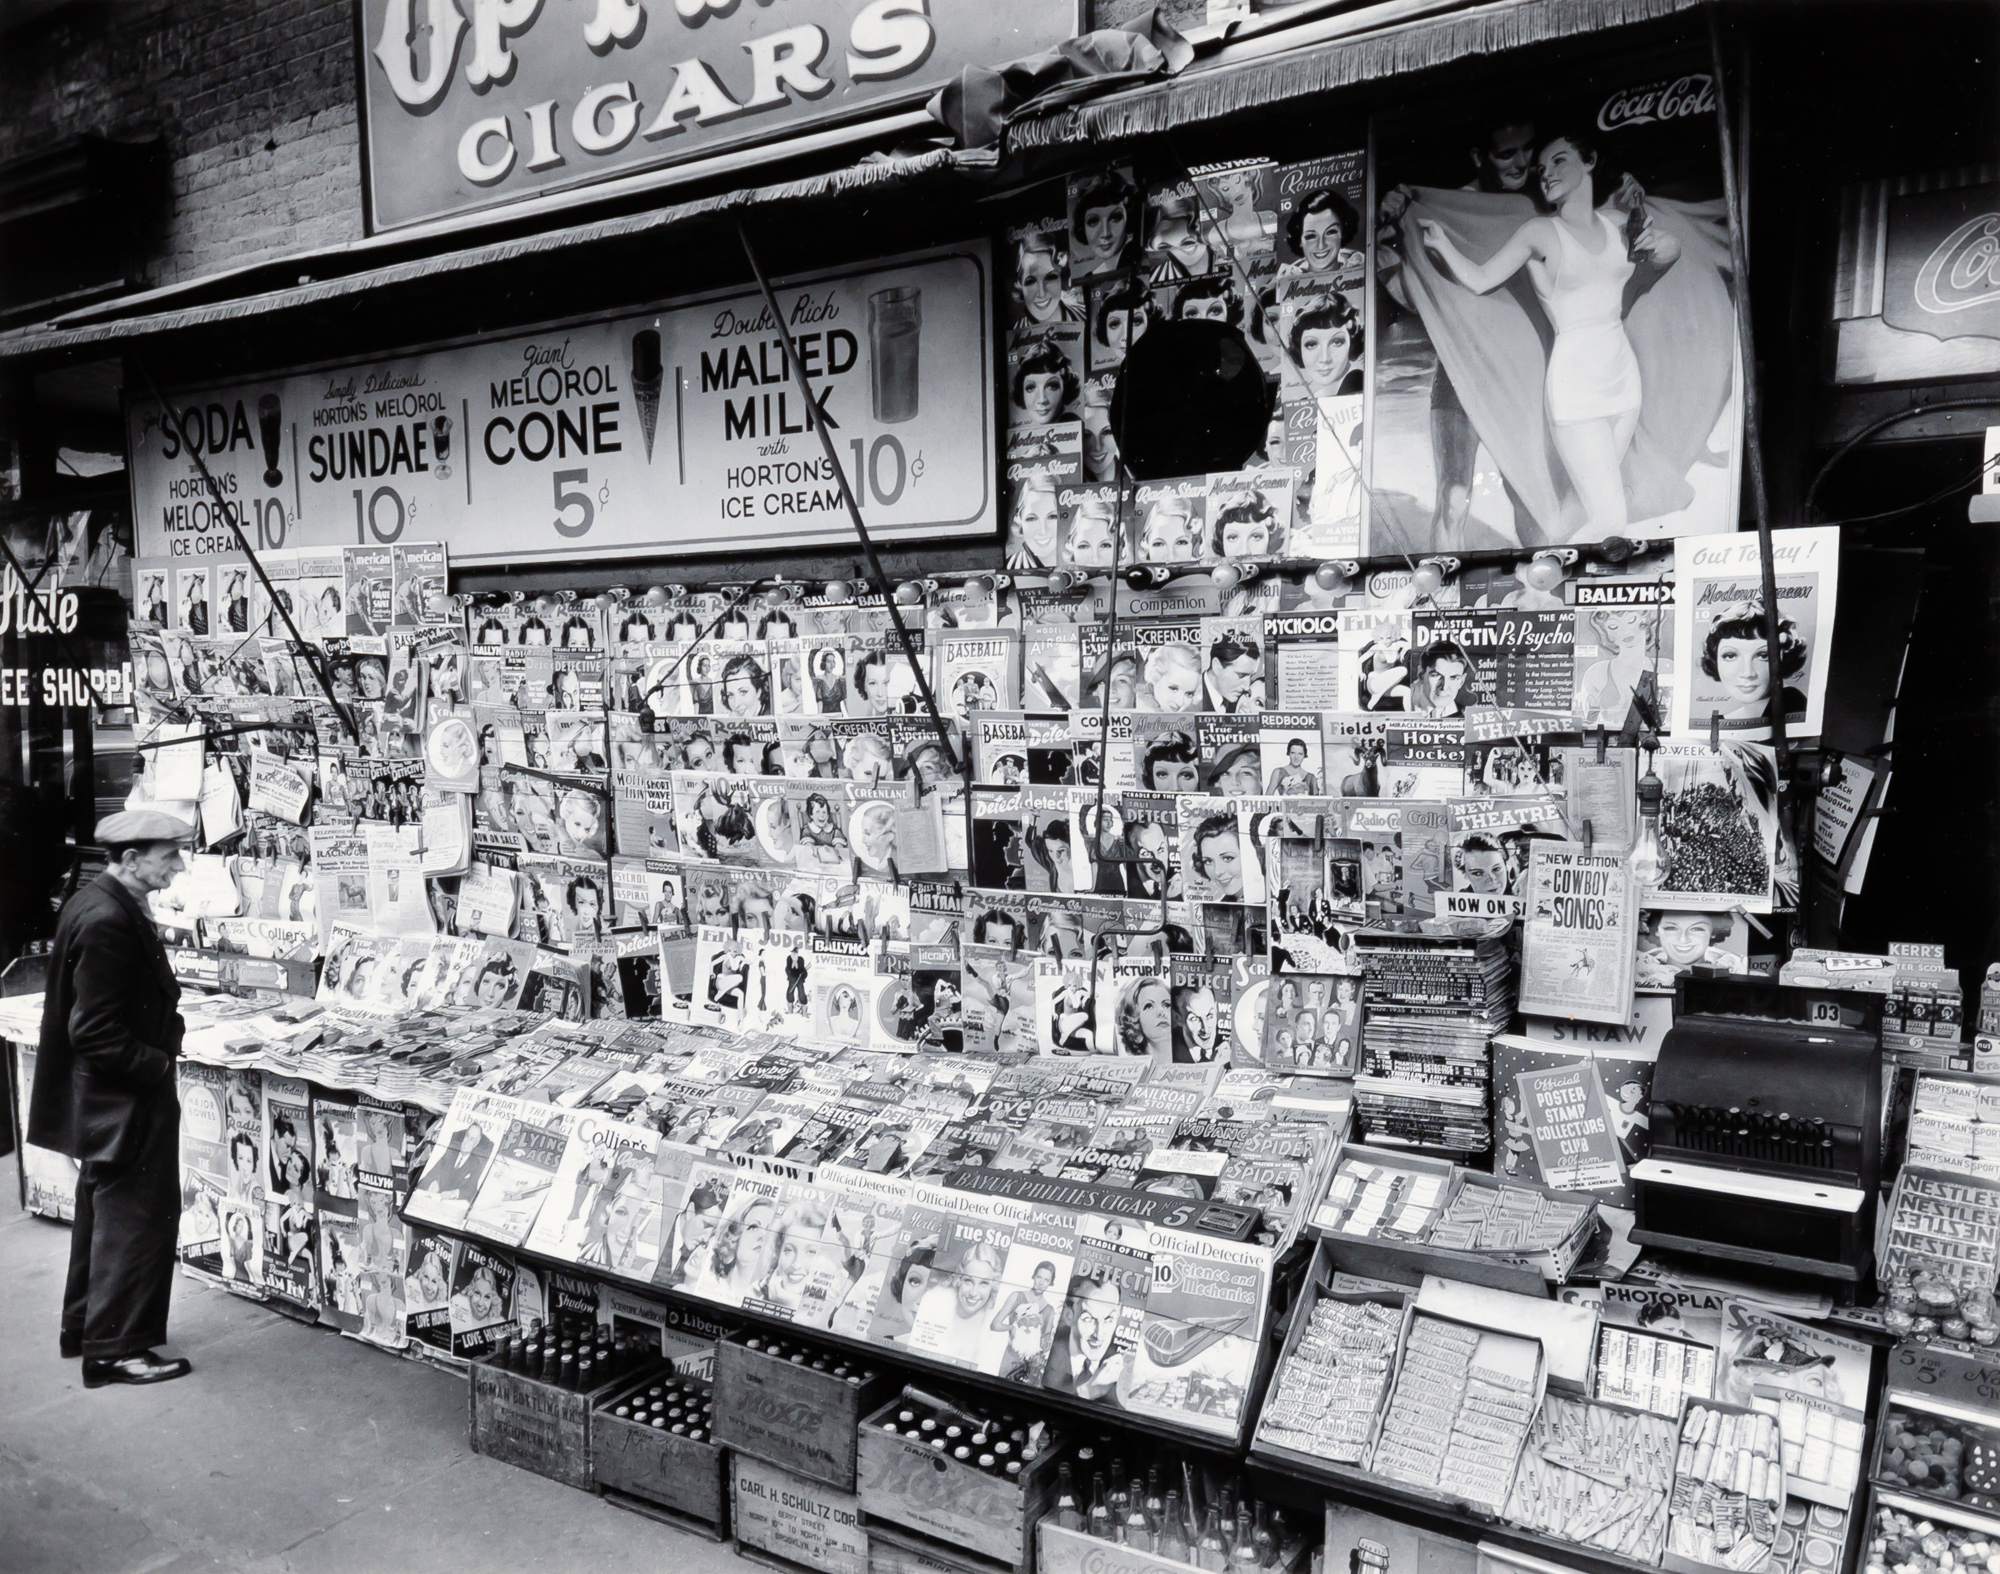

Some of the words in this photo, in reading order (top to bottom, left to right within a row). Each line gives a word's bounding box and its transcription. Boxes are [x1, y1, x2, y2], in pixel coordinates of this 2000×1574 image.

[457, 0, 935, 184] CIGARS
[1187, 156, 1271, 176] BALLYHOO
[1307, 160, 1356, 177] Modern
[1280, 169, 1364, 195] Romances
[1280, 201, 1293, 212] 10
[1283, 281, 1330, 302] Modern
[790, 290, 840, 325] Rich
[700, 328, 859, 394] MALTED
[323, 376, 358, 402] Simply
[364, 373, 426, 396] Delicious
[490, 365, 618, 409] MELOROL
[313, 401, 368, 427] HORTON'S
[376, 392, 446, 419] MELOROL
[724, 385, 841, 441] MILK
[161, 400, 255, 460] SODA
[484, 401, 622, 466] CONE
[757, 437, 790, 456] with
[1010, 432, 1046, 450] Modern
[1046, 430, 1079, 444] Screen
[308, 421, 430, 484] SUNDAE
[727, 457, 836, 489] HORTON'S
[1045, 459, 1079, 476] Stars
[169, 472, 238, 499] HORTON'S
[1209, 477, 1253, 497] Modern
[1252, 475, 1290, 492] Screen
[721, 496, 755, 519] ICE
[763, 488, 844, 516] CREAM
[1135, 487, 1182, 505] Radio
[163, 500, 251, 533] MELOROL
[170, 537, 191, 556] ICE
[1693, 547, 1733, 565] Out
[1697, 583, 1758, 606] Modern
[557, 599, 596, 616] Radio
[1130, 596, 1206, 615] Companion
[1434, 619, 1474, 629] MASTER
[1538, 614, 1556, 622] THE
[1136, 625, 1178, 647] SCREEN
[947, 640, 1005, 663] BASEBALL
[554, 659, 602, 672] DETECTIVE
[1261, 715, 1317, 726] REDBOOK
[1473, 710, 1514, 723] NEW
[1208, 723, 1232, 733] True
[1474, 719, 1575, 743] THEATRE
[646, 780, 670, 791] SHORT
[647, 792, 671, 800] WAVE
[647, 800, 671, 811] CRAFT
[1128, 801, 1149, 809] TRUE
[1454, 801, 1494, 816] NEW
[1455, 804, 1561, 832] THEATRE
[490, 834, 499, 844] ON
[316, 850, 352, 858] RACING
[1546, 853, 1572, 865] NEW
[1577, 856, 1619, 868] EDITION
[1553, 868, 1609, 896] COWBOY
[1448, 898, 1481, 914] NOW
[1487, 899, 1506, 914] ON
[1553, 896, 1605, 930] SONGS
[1890, 944, 1943, 957] KERR'S
[1832, 958, 1881, 968] P.K.
[1814, 1004, 1839, 1021] .03
[1554, 1023, 1647, 1044] STRAW
[281, 1082, 306, 1099] Today
[1534, 1073, 1581, 1089] Official
[188, 1098, 215, 1110] MAJOR
[457, 1091, 474, 1100] THE
[1132, 1086, 1197, 1105] RAILROAD
[1536, 1087, 1587, 1107] POSTER
[1143, 1100, 1191, 1114] STORIES
[1545, 1105, 1586, 1124] STAMP
[228, 1115, 262, 1134] Radio
[456, 1112, 495, 1132] Liberty
[1104, 1114, 1177, 1127] NORTHWEST
[1536, 1117, 1606, 1141] COLLECTORS
[1914, 1116, 1974, 1134] SPORTSMAN'S
[505, 1130, 565, 1153] FLYING
[1252, 1131, 1313, 1160] SPIDER
[1560, 1136, 1589, 1154] CLUB
[528, 1150, 560, 1167] ACES
[1070, 1147, 1142, 1170] HORROR
[1910, 1150, 1970, 1168] SPORTSMAN'S
[762, 1160, 800, 1181] NOW
[1233, 1160, 1300, 1187] SPIDER
[734, 1176, 779, 1198] PICTURE
[821, 1166, 856, 1184] Official
[859, 1177, 907, 1197] Detective
[1588, 1179, 1618, 1187] AMERICAN
[956, 1172, 1021, 1192] BAYUK
[1101, 1190, 1156, 1214] CIGAR
[1017, 1229, 1074, 1250] REDBOOK
[1085, 1251, 1112, 1262] TRUE
[1133, 1250, 1149, 1259] THE
[1150, 1232, 1199, 1252] Official
[1202, 1241, 1264, 1267] Detective
[1154, 1265, 1172, 1283] 10
[1231, 1272, 1254, 1287] and
[1182, 1276, 1255, 1304] Mechanics
[1604, 1286, 1731, 1312] PHOTOPLAY
[556, 1292, 594, 1314] Shadow
[1727, 1303, 1866, 1353] SCREENLAND
[462, 1329, 484, 1349] LOVE
[1900, 1350, 1916, 1365] 5
[1784, 1390, 1834, 1413] Chiclets
[741, 1478, 766, 1499] CARL
[770, 1487, 779, 1503] H.
[782, 1492, 831, 1520] SCHULTZ
[801, 1518, 825, 1532] STREET
[800, 1530, 822, 1542] NORTH
